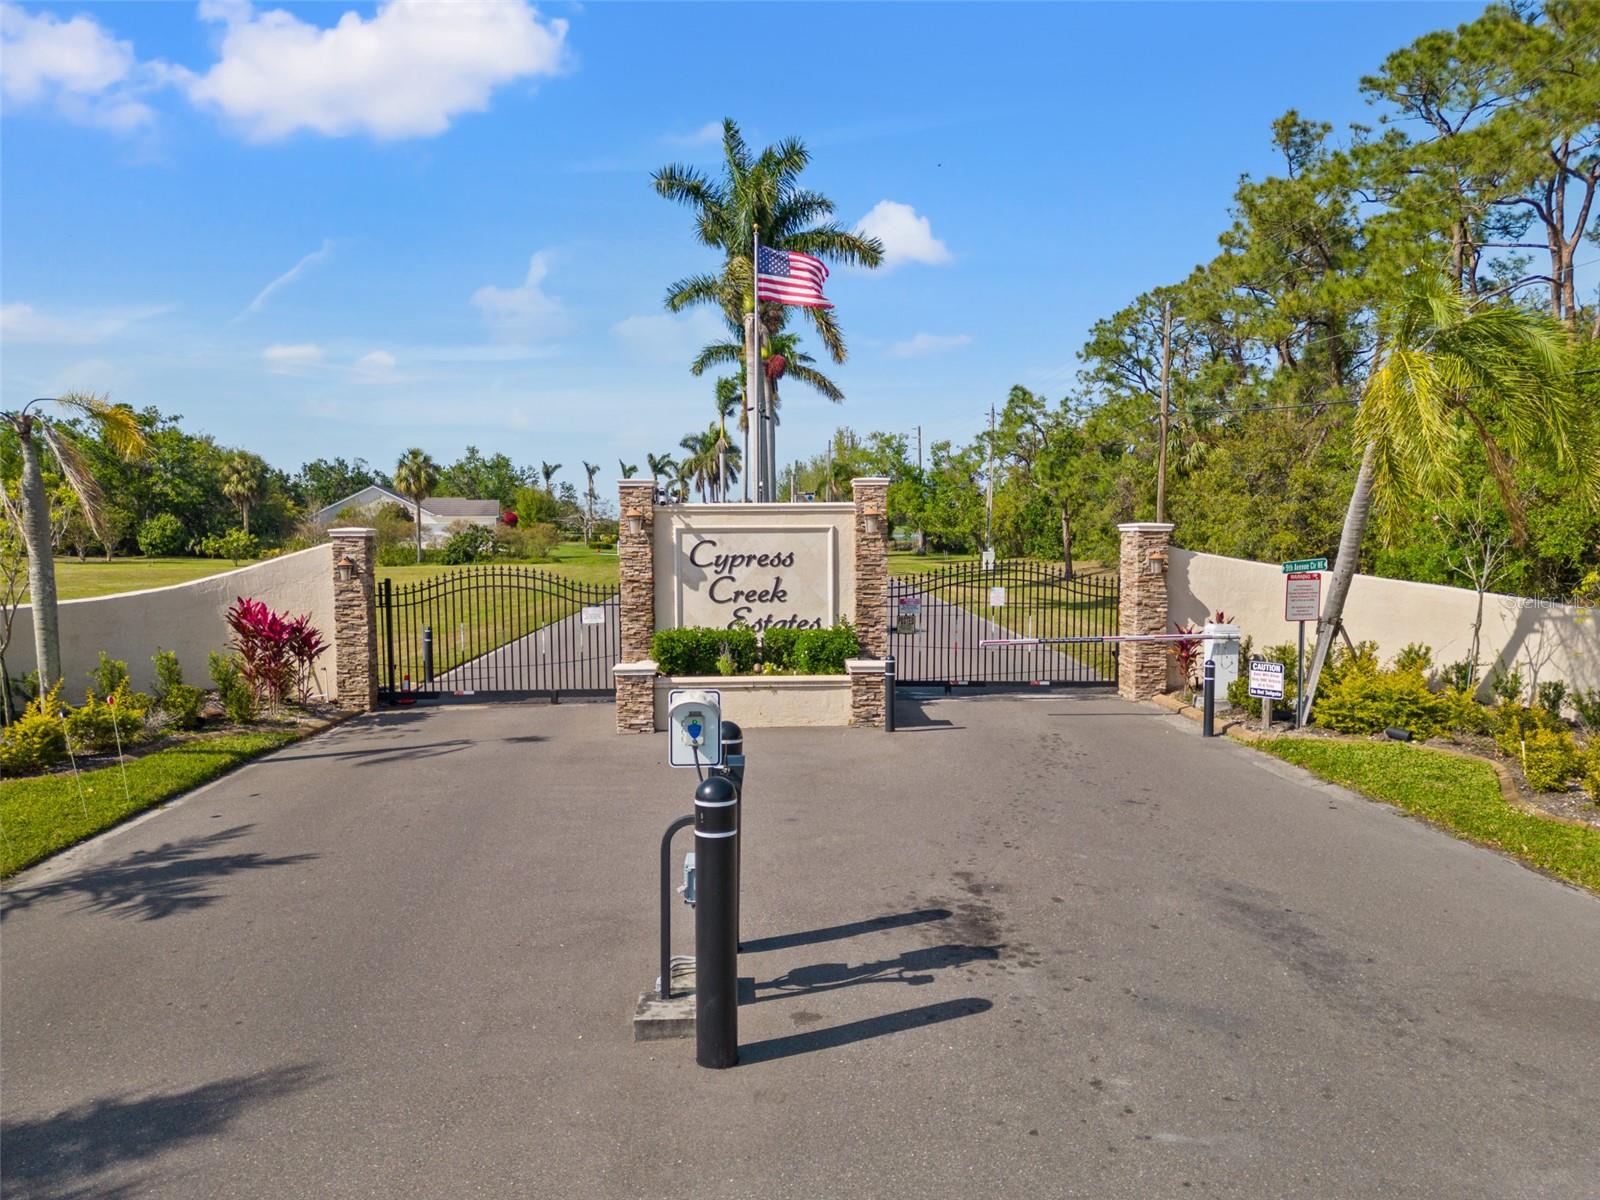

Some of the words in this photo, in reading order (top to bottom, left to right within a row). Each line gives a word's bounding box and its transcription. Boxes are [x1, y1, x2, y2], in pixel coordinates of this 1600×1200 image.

[689, 539, 795, 575] Cypress
[708, 575, 788, 605] Creek
[727, 606, 822, 633] Estates
[1252, 663, 1281, 672] CAUTION
